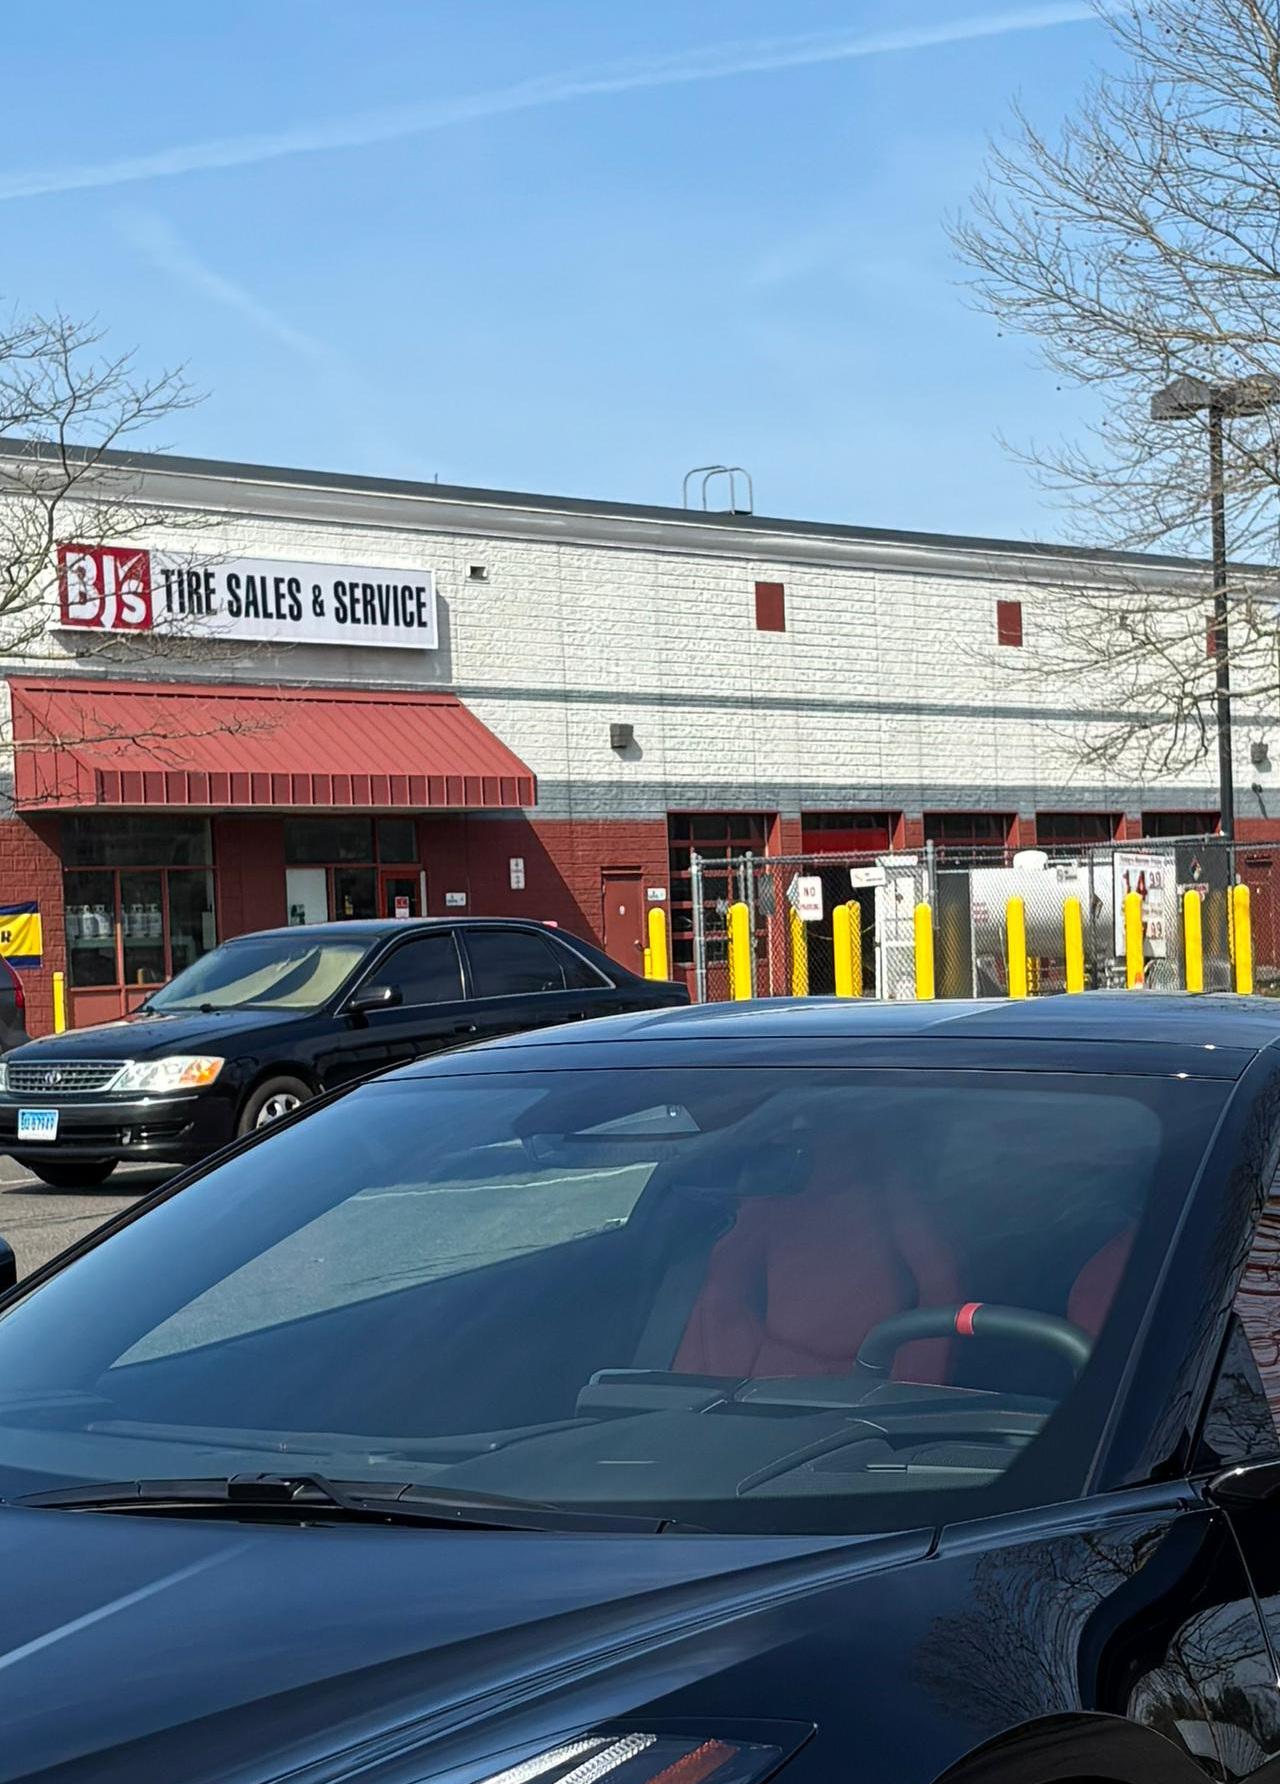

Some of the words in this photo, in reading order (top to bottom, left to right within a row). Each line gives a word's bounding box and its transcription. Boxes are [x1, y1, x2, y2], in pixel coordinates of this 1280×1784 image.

[160, 567, 217, 616] TIRE
[226, 572, 302, 622] SALES
[311, 583, 326, 618] &
[333, 580, 428, 628] SERVICE
[803, 886, 816, 897] NO
